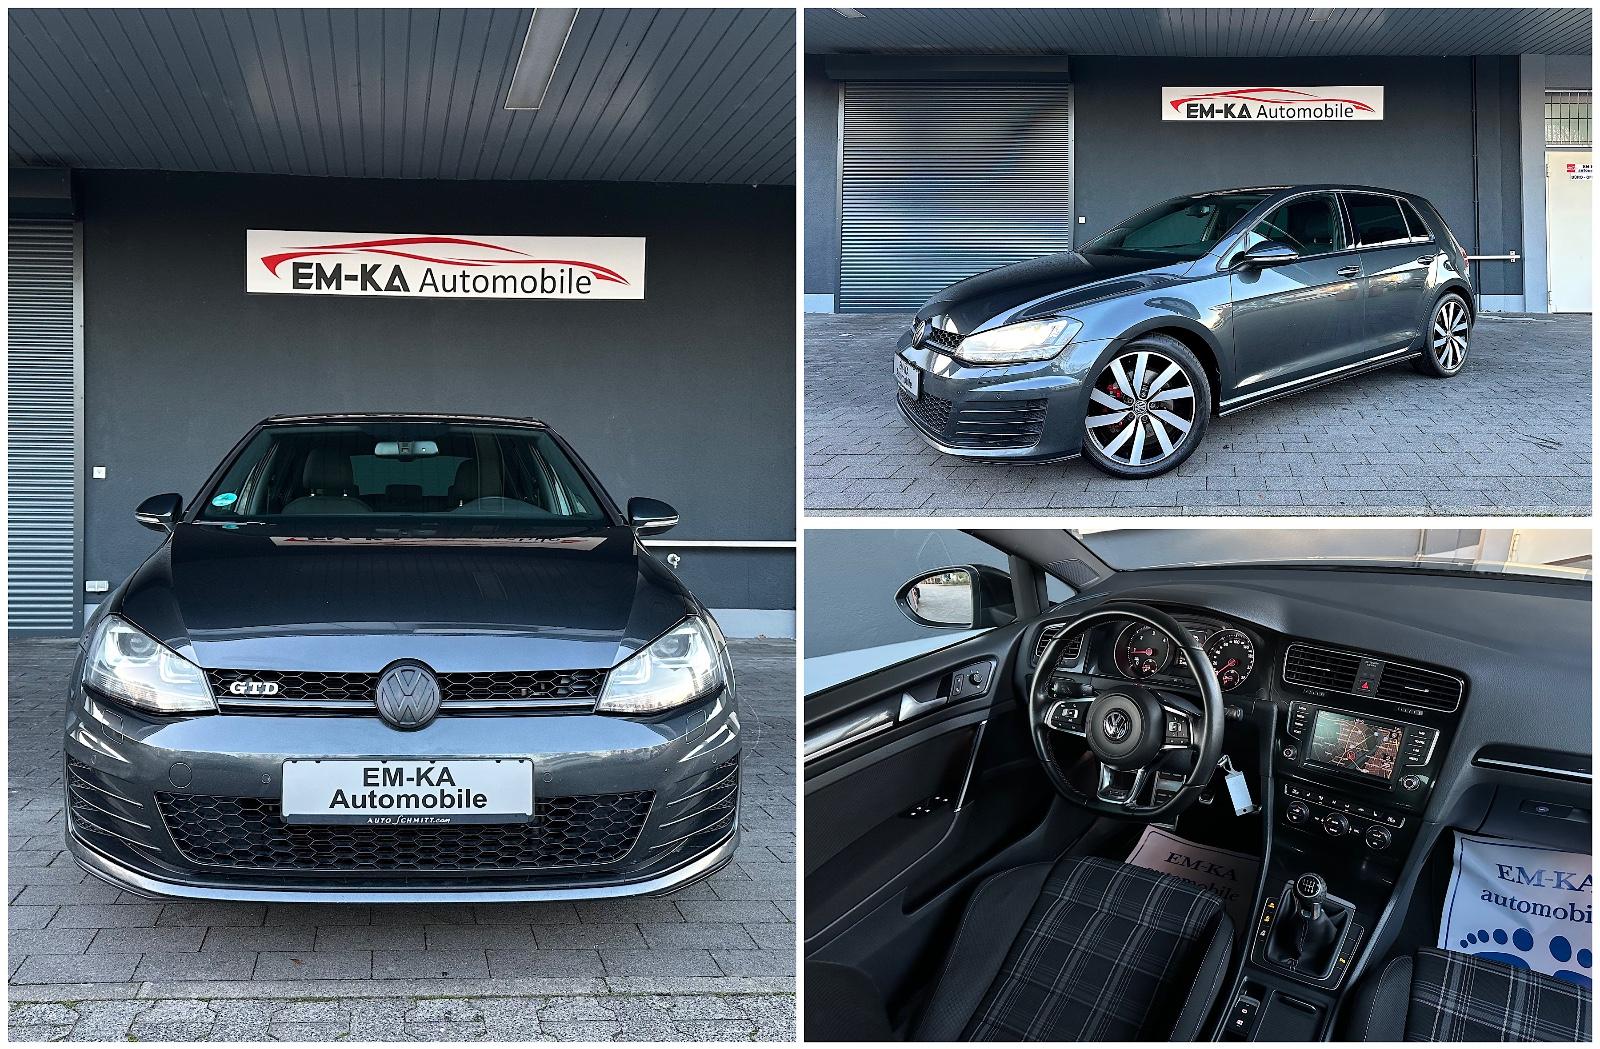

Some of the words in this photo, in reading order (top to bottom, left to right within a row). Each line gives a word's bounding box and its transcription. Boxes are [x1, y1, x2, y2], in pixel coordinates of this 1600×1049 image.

[1186, 103, 1252, 119] EM-KA
[1256, 104, 1354, 119] Automobile
[291, 261, 411, 293] EM-KA
[418, 267, 592, 295] Automobile
[229, 681, 279, 695] GTD
[363, 766, 457, 787] EM-KA
[328, 788, 488, 809] Automobile
[1163, 851, 1239, 882] EM-KA
[1495, 863, 1592, 894] EM-KA
